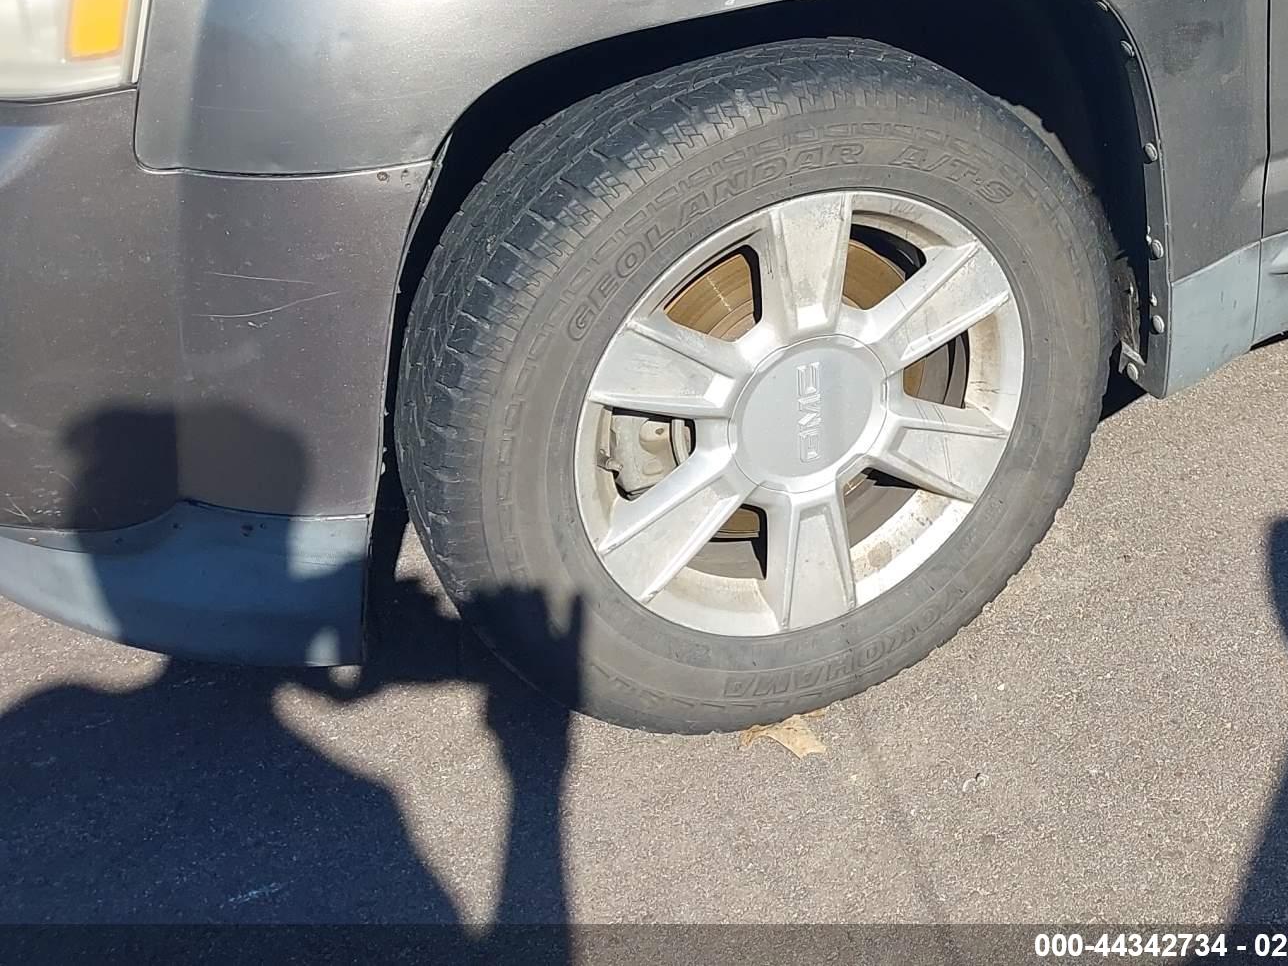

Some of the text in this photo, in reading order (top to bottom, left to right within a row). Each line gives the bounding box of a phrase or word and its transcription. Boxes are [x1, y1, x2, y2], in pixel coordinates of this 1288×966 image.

[567, 142, 867, 342] GEOLANDAR
[796, 361, 822, 464] GMC
[722, 586, 968, 699] YOKOHAMA
